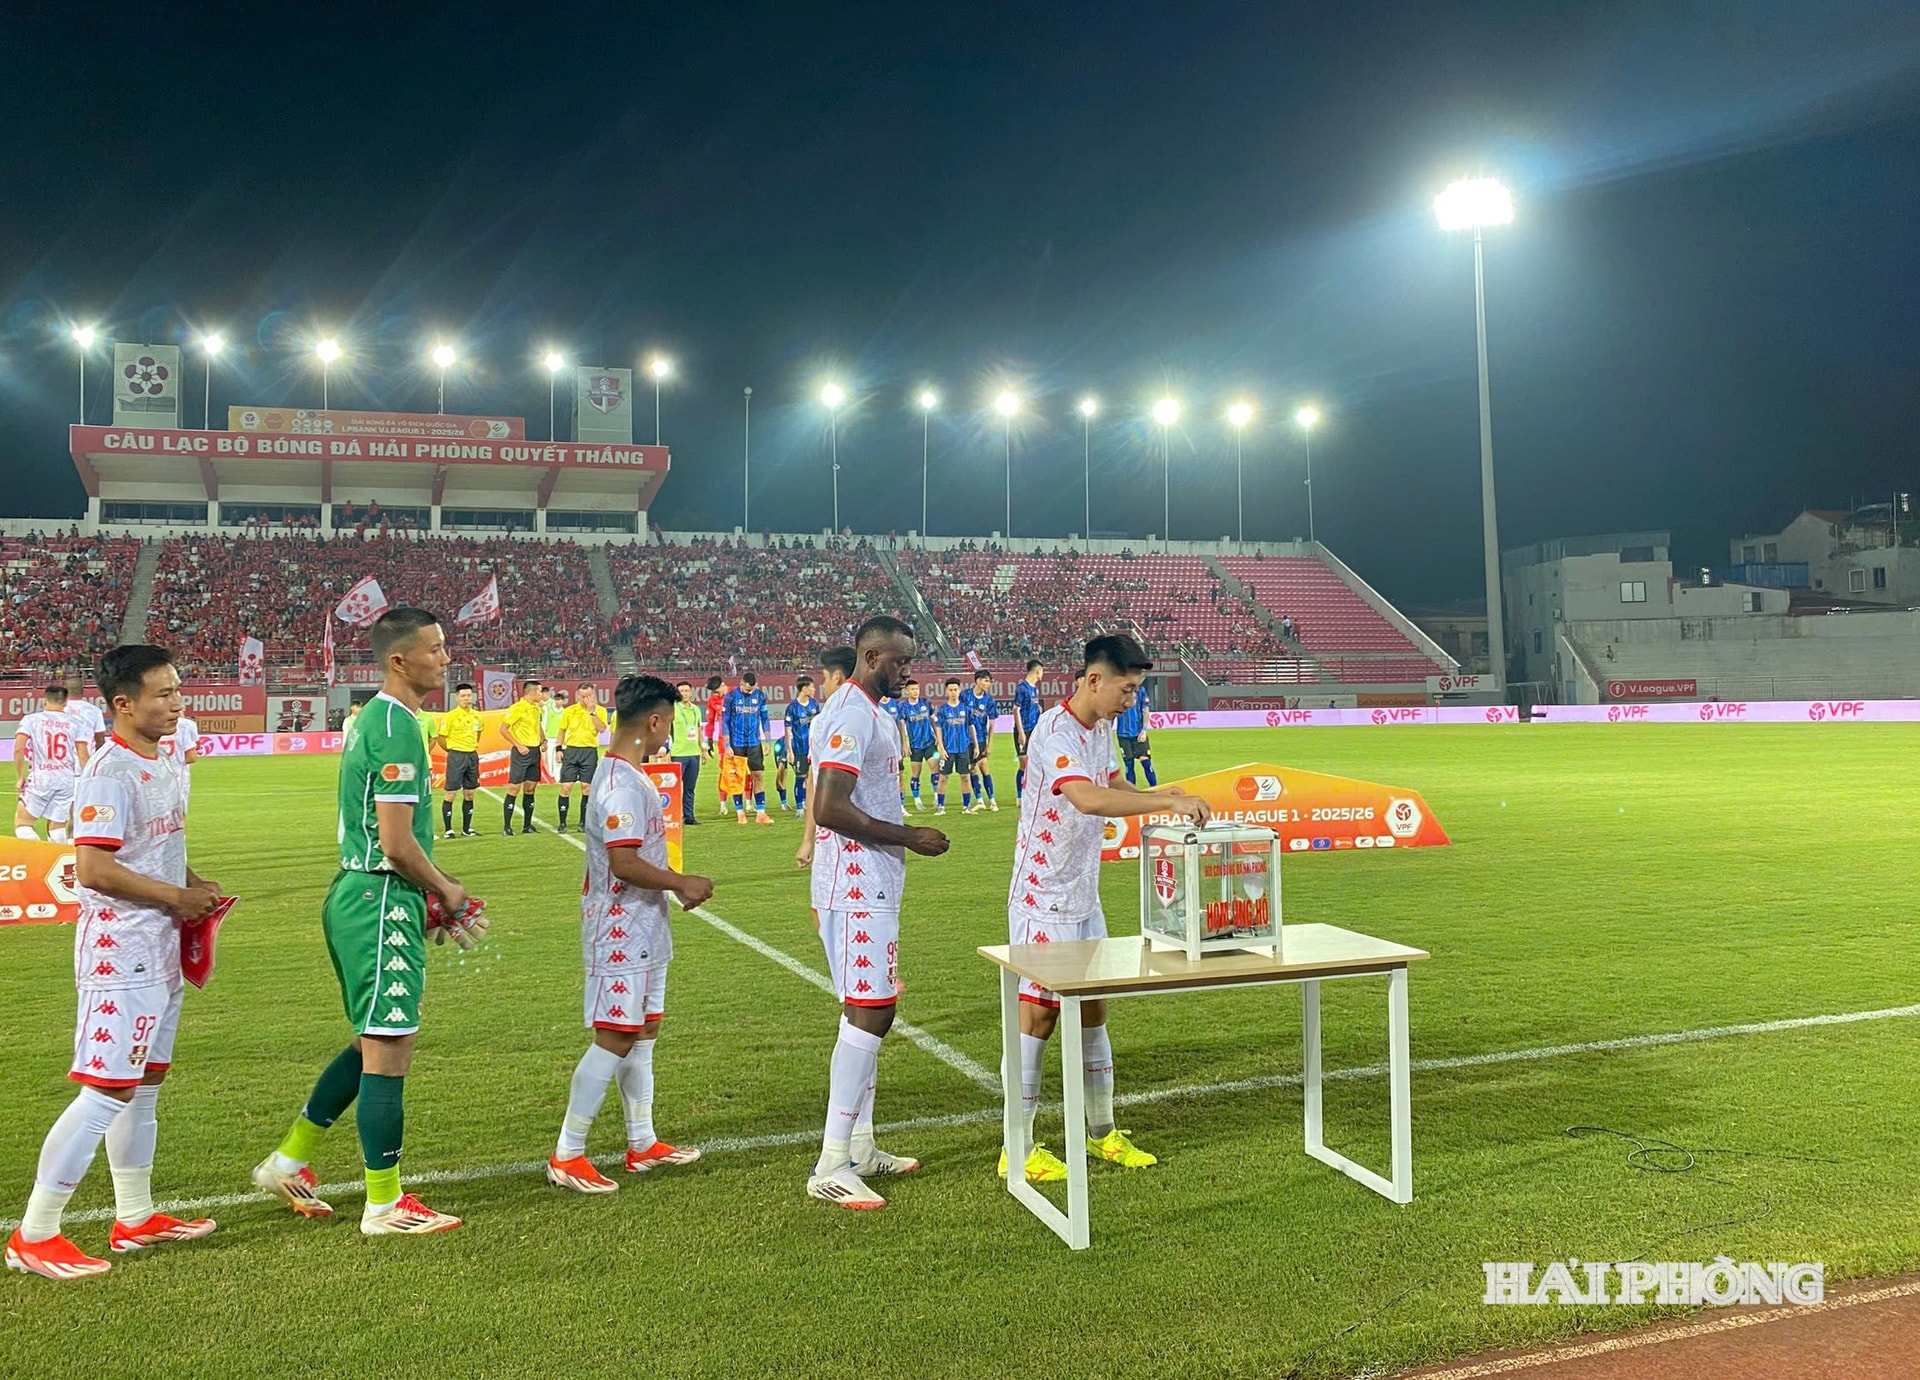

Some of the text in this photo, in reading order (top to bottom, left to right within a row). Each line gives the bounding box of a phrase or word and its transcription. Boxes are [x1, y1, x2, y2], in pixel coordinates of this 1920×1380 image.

[103, 432, 644, 465] CÂU LẠC BỘ BÓNG ĐÁ HẢI PHÒNG QUYẾT THẮNG
[1453, 676, 1479, 687] VPF
[1629, 684, 1695, 695] V.League.VPF
[1232, 701, 1280, 710] Kappa
[1622, 706, 1649, 718] VPF
[1716, 704, 1747, 717] VPF
[1828, 702, 1864, 716] VPF
[1165, 712, 1198, 725] VPF
[1281, 711, 1312, 723] VPF
[1388, 709, 1421, 720] VPF
[44, 730, 68, 761] 16
[218, 735, 264, 750] VPF
[1292, 809, 1300, 822] 1
[1311, 807, 1375, 822] 2025/26
[132, 1015, 156, 1042] 97
